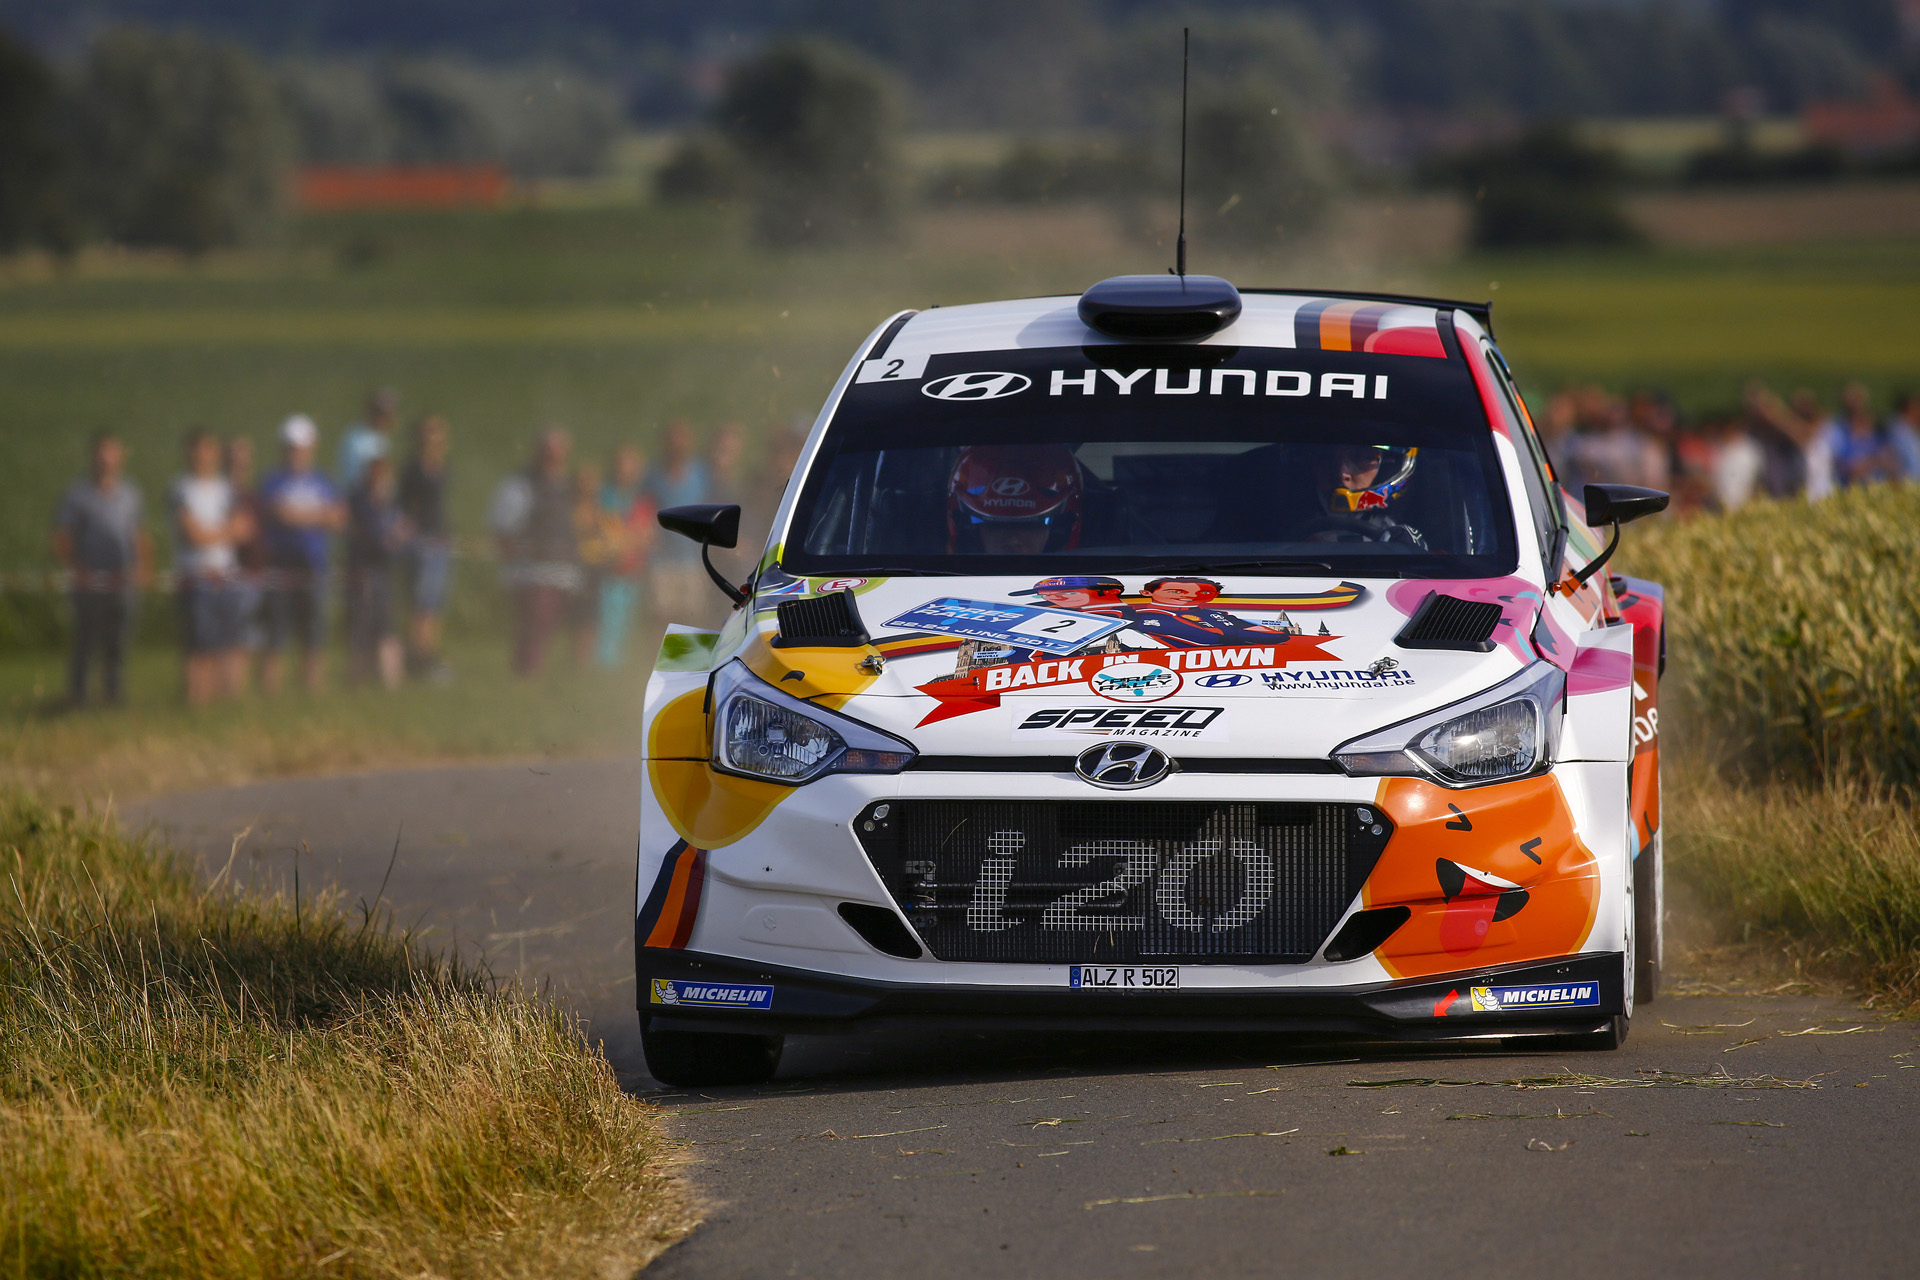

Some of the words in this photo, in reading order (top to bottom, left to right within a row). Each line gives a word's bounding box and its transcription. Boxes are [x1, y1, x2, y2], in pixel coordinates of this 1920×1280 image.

[881, 358, 905, 379] 2
[1049, 368, 1388, 399] HYUNDAI
[984, 499, 1037, 509] HYUNDAI
[913, 608, 1013, 624] RALLY
[928, 604, 1024, 618] YPRES
[1041, 620, 1077, 633] 2
[954, 629, 1010, 640] JUNE
[1014, 636, 1070, 650] 2017
[985, 658, 1085, 692] BACK
[1102, 653, 1140, 668] IN
[1165, 648, 1275, 670] TOWN
[1261, 671, 1411, 682] HYUNDAI
[1094, 674, 1171, 685] YPRES
[1099, 680, 1172, 691] RALLY
[1268, 679, 1415, 690] www.hyundai.be
[1017, 706, 1225, 730] SPEED
[1112, 728, 1202, 738] MAGAZINE
[1082, 968, 1118, 986] ALZ
[1123, 968, 1136, 986] R
[1142, 968, 1177, 987] 502
[682, 986, 768, 1002] MICHELIN
[1502, 986, 1592, 1003] MICHELIN
